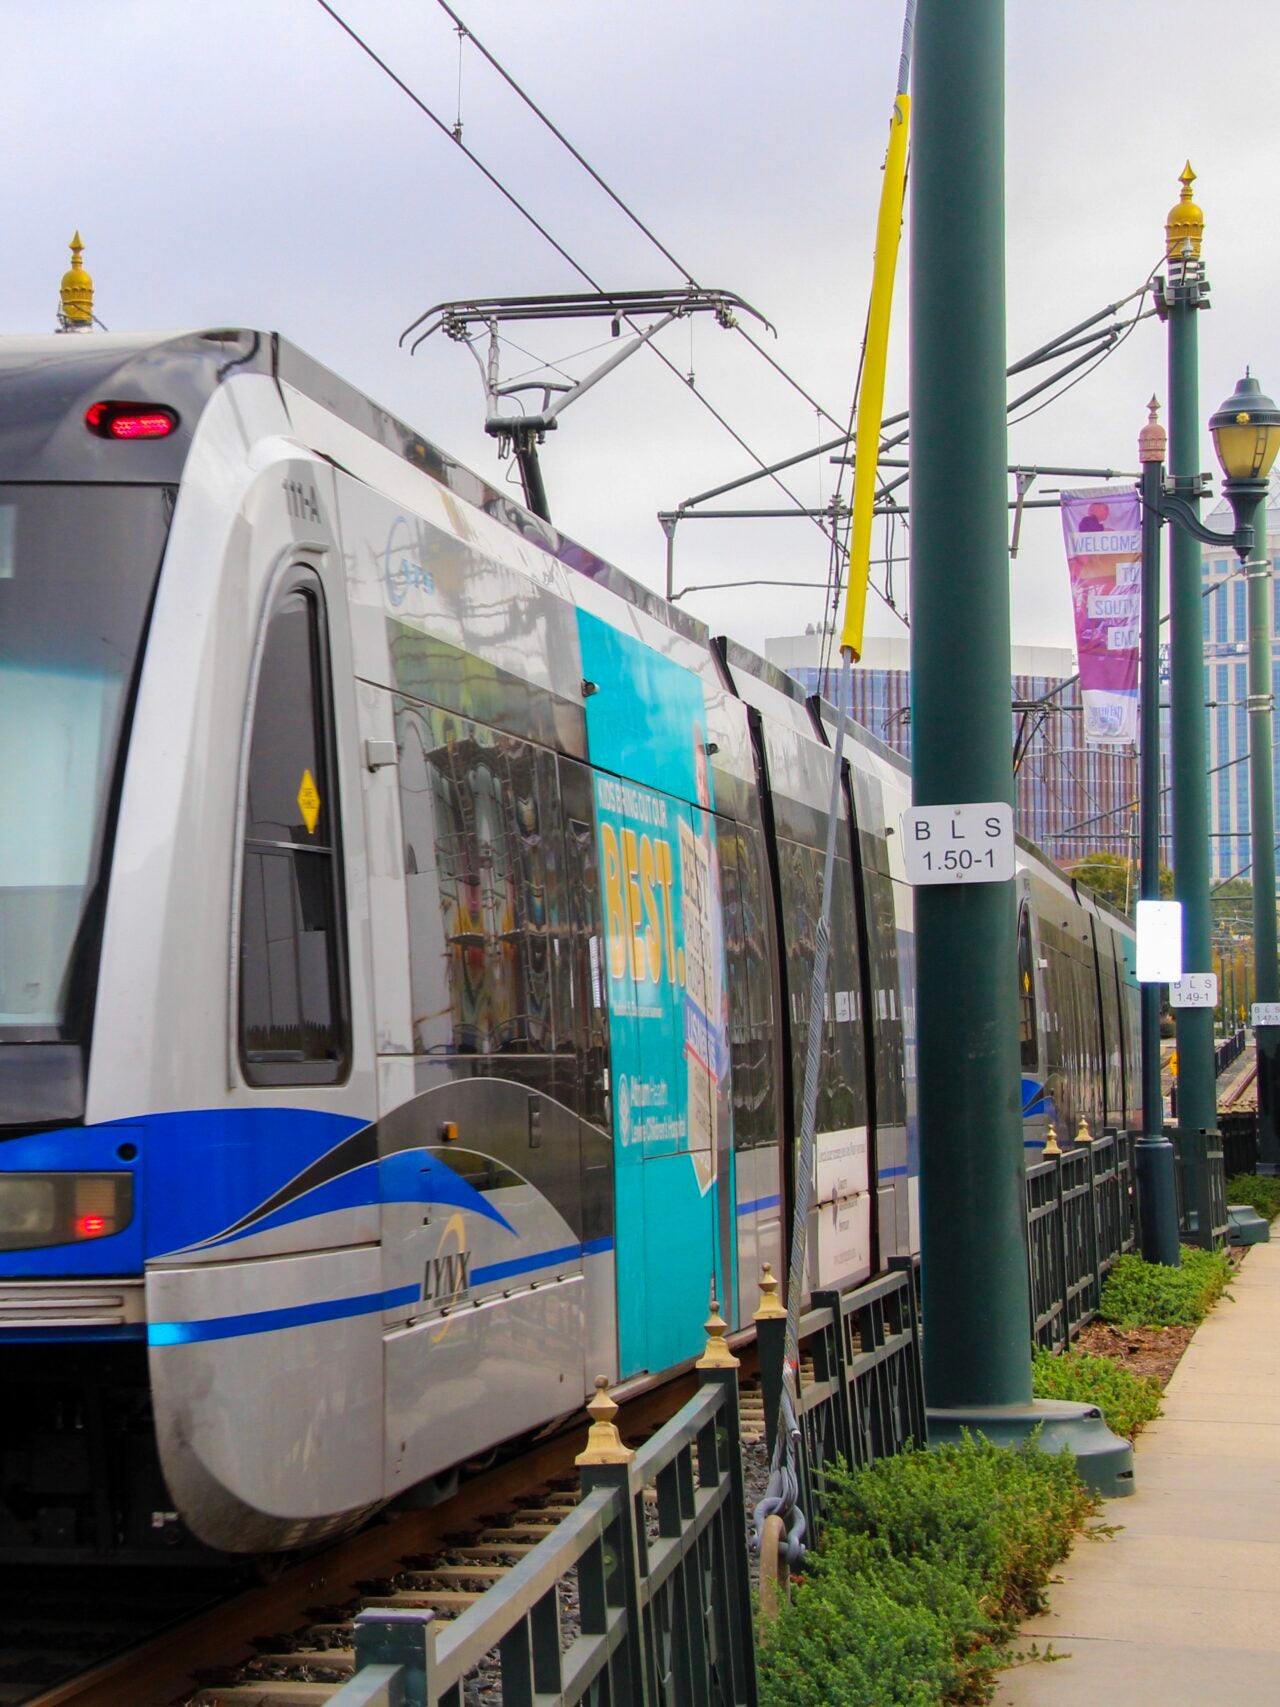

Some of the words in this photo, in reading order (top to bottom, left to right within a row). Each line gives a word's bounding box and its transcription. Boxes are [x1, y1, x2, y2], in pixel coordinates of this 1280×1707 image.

[1072, 535, 1138, 552] WELCOME
[922, 848, 994, 871] 1.50-1
[601, 822, 686, 988] BEST.
[1177, 992, 1209, 1002] 1.49-1
[423, 1250, 471, 1301] LYNX
